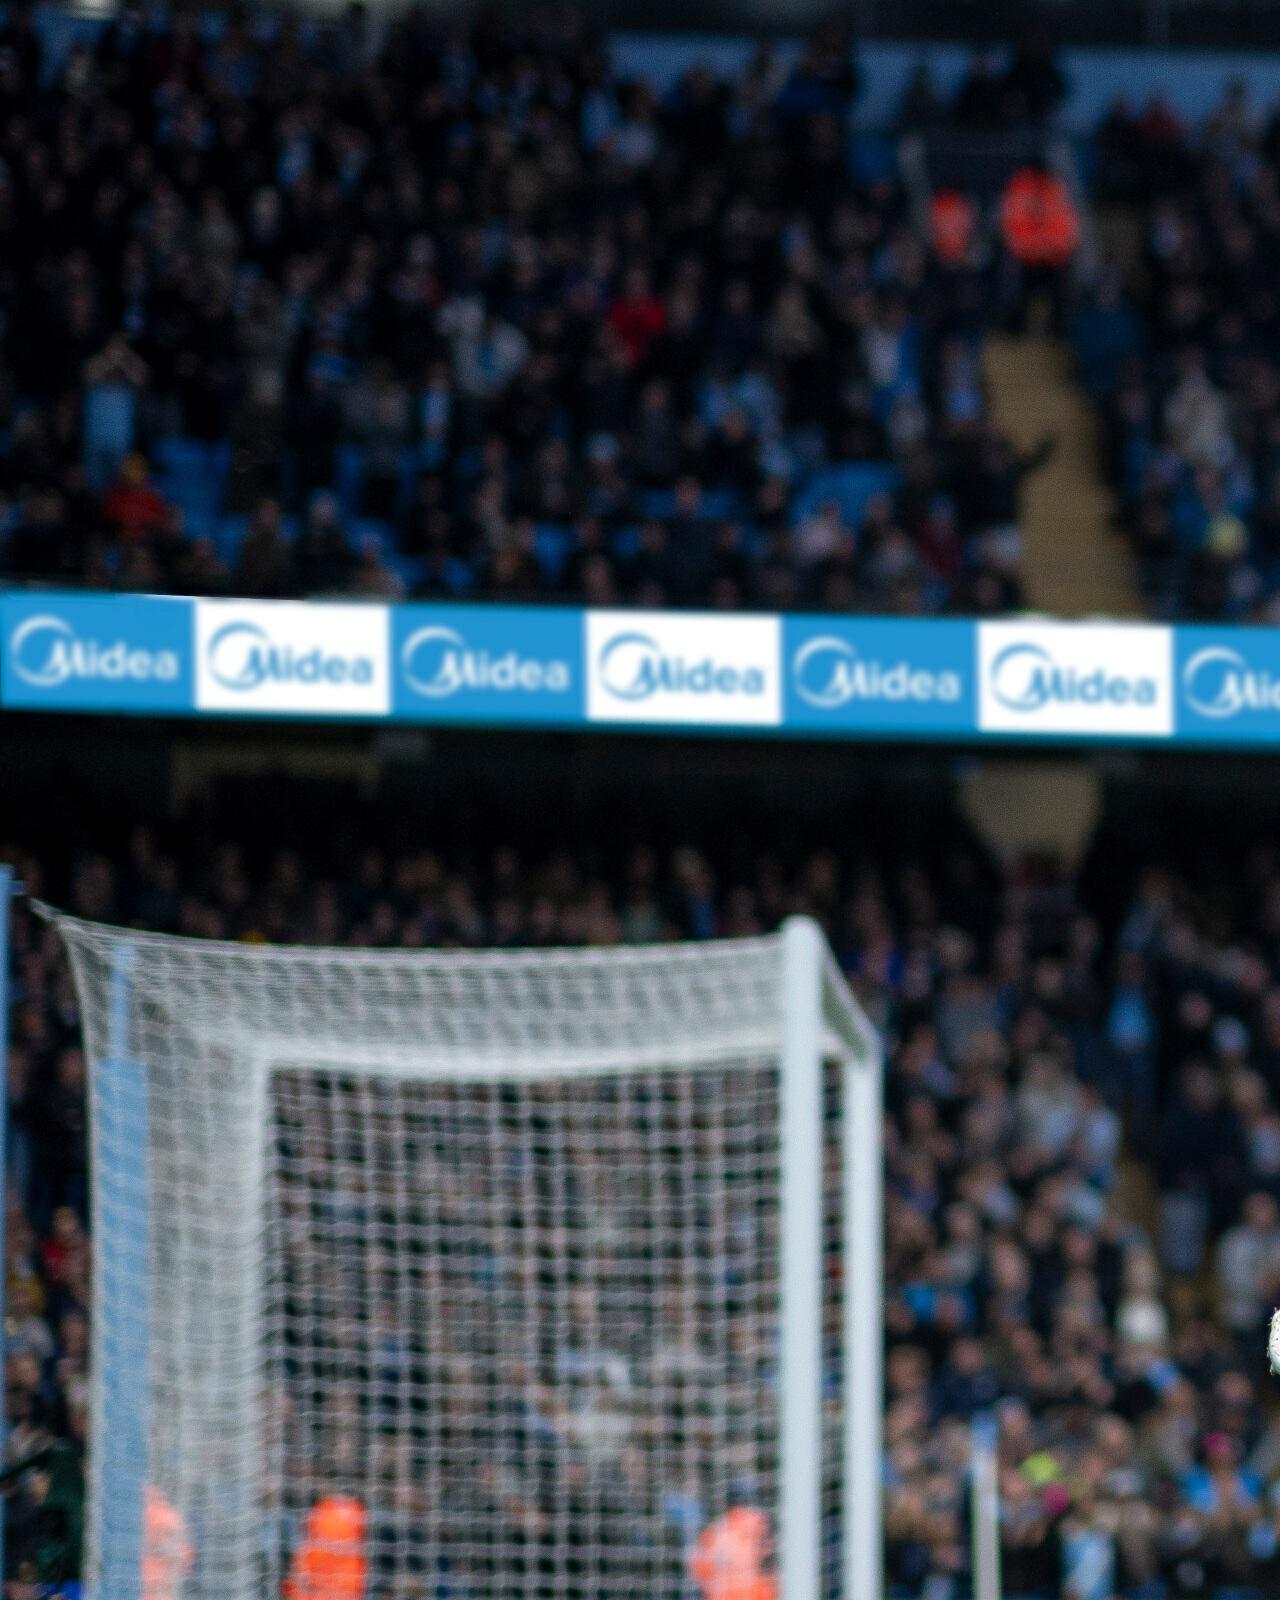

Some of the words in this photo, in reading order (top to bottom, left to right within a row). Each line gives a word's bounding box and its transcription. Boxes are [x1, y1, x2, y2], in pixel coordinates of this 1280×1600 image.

[45, 638, 179, 680] Midea
[241, 643, 375, 685] Midea
[436, 648, 570, 691] Midea
[631, 654, 766, 696] Midea
[826, 659, 961, 701] Midea
[1022, 664, 1158, 707] Midea
